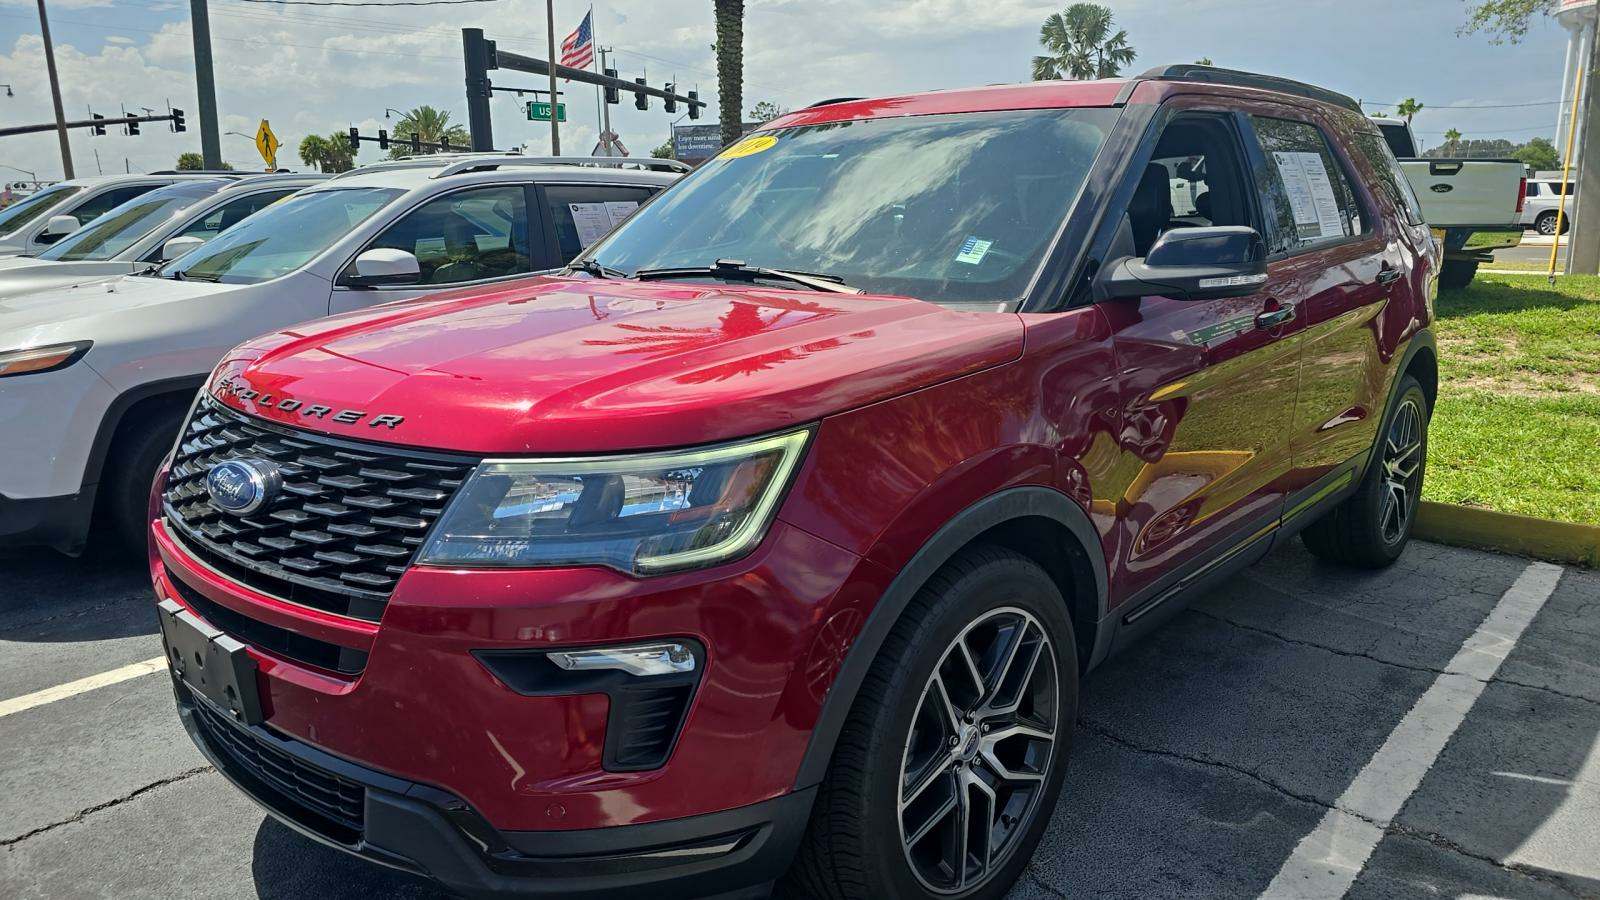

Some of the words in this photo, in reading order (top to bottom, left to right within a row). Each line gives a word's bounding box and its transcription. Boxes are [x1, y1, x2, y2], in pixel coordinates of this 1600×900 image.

[539, 107, 552, 116] US
[678, 135, 692, 143] Enjoy
[220, 379, 404, 428] EXPLORER
